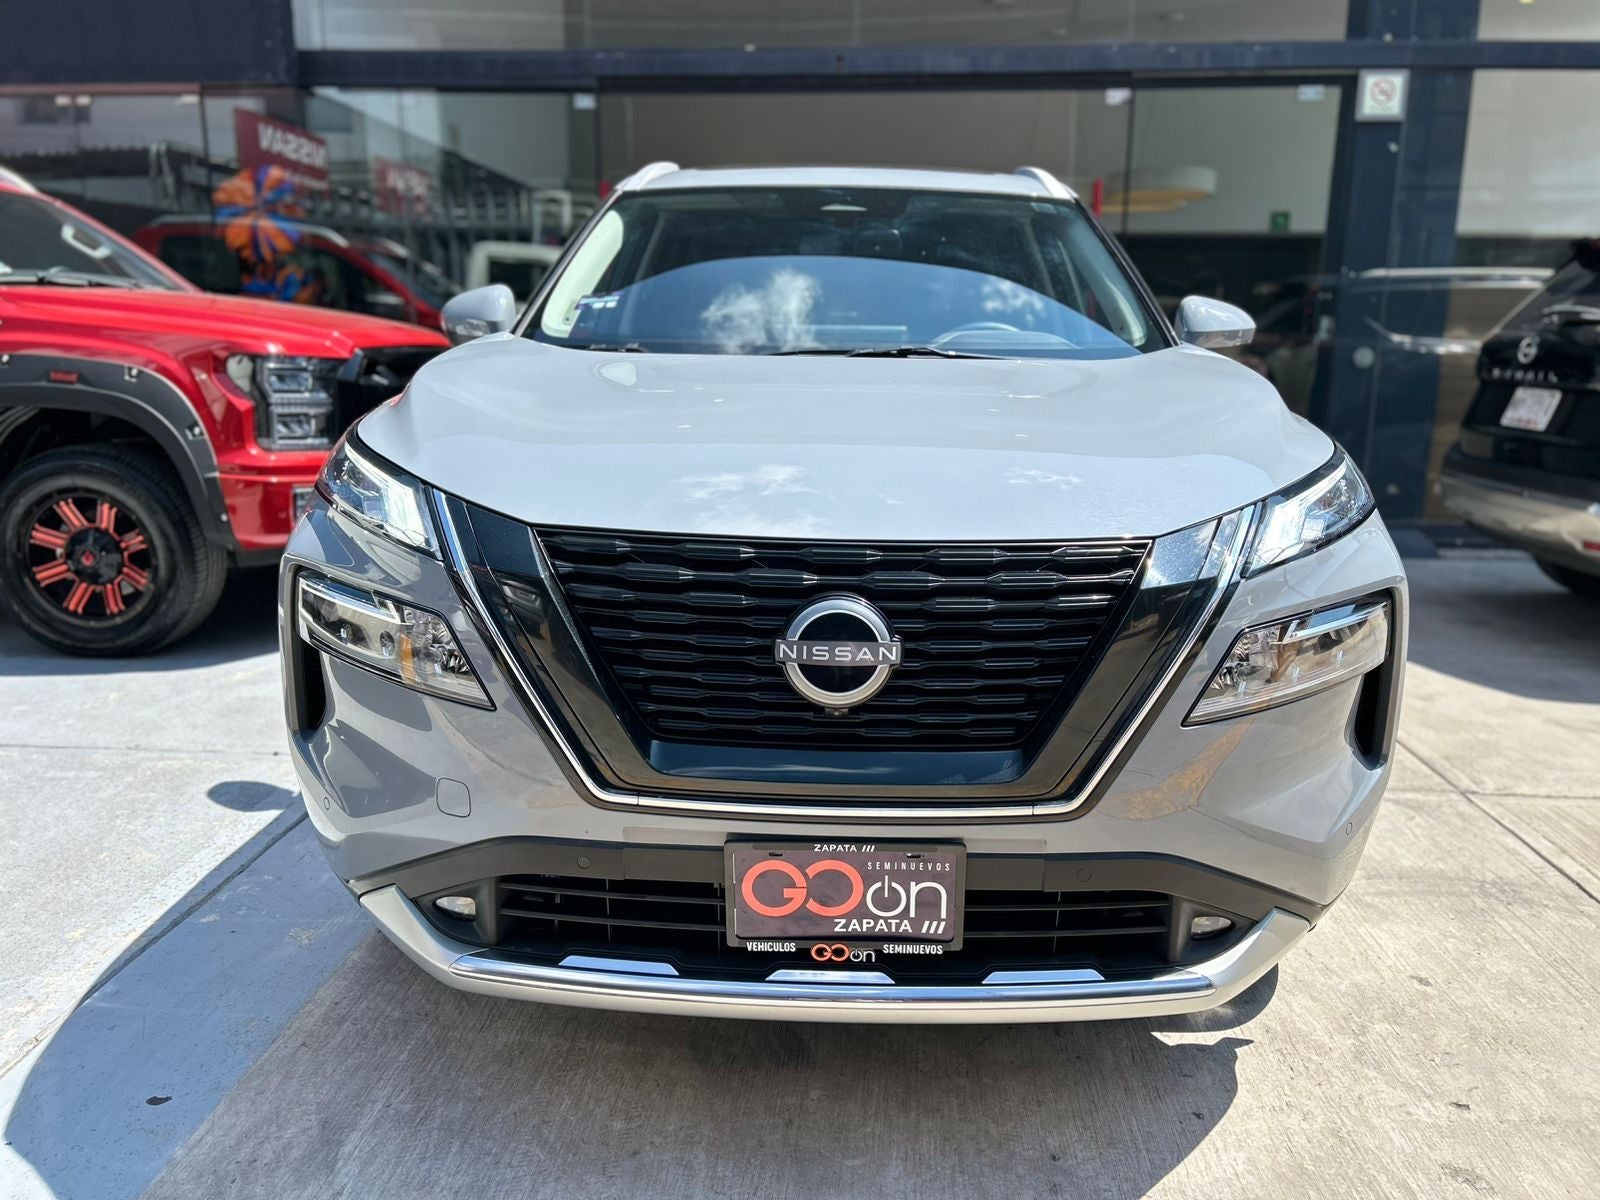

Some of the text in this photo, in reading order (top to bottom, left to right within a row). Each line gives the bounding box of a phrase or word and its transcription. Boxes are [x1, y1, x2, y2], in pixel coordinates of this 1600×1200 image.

[779, 643, 897, 661] NISSAN
[814, 844, 857, 852] ZAPATA
[867, 861, 950, 872] SEMINUEVOS
[833, 918, 912, 933] ZAPATA
[746, 941, 796, 952] VEHICULOS
[883, 944, 943, 954] SEMINUEVOS
